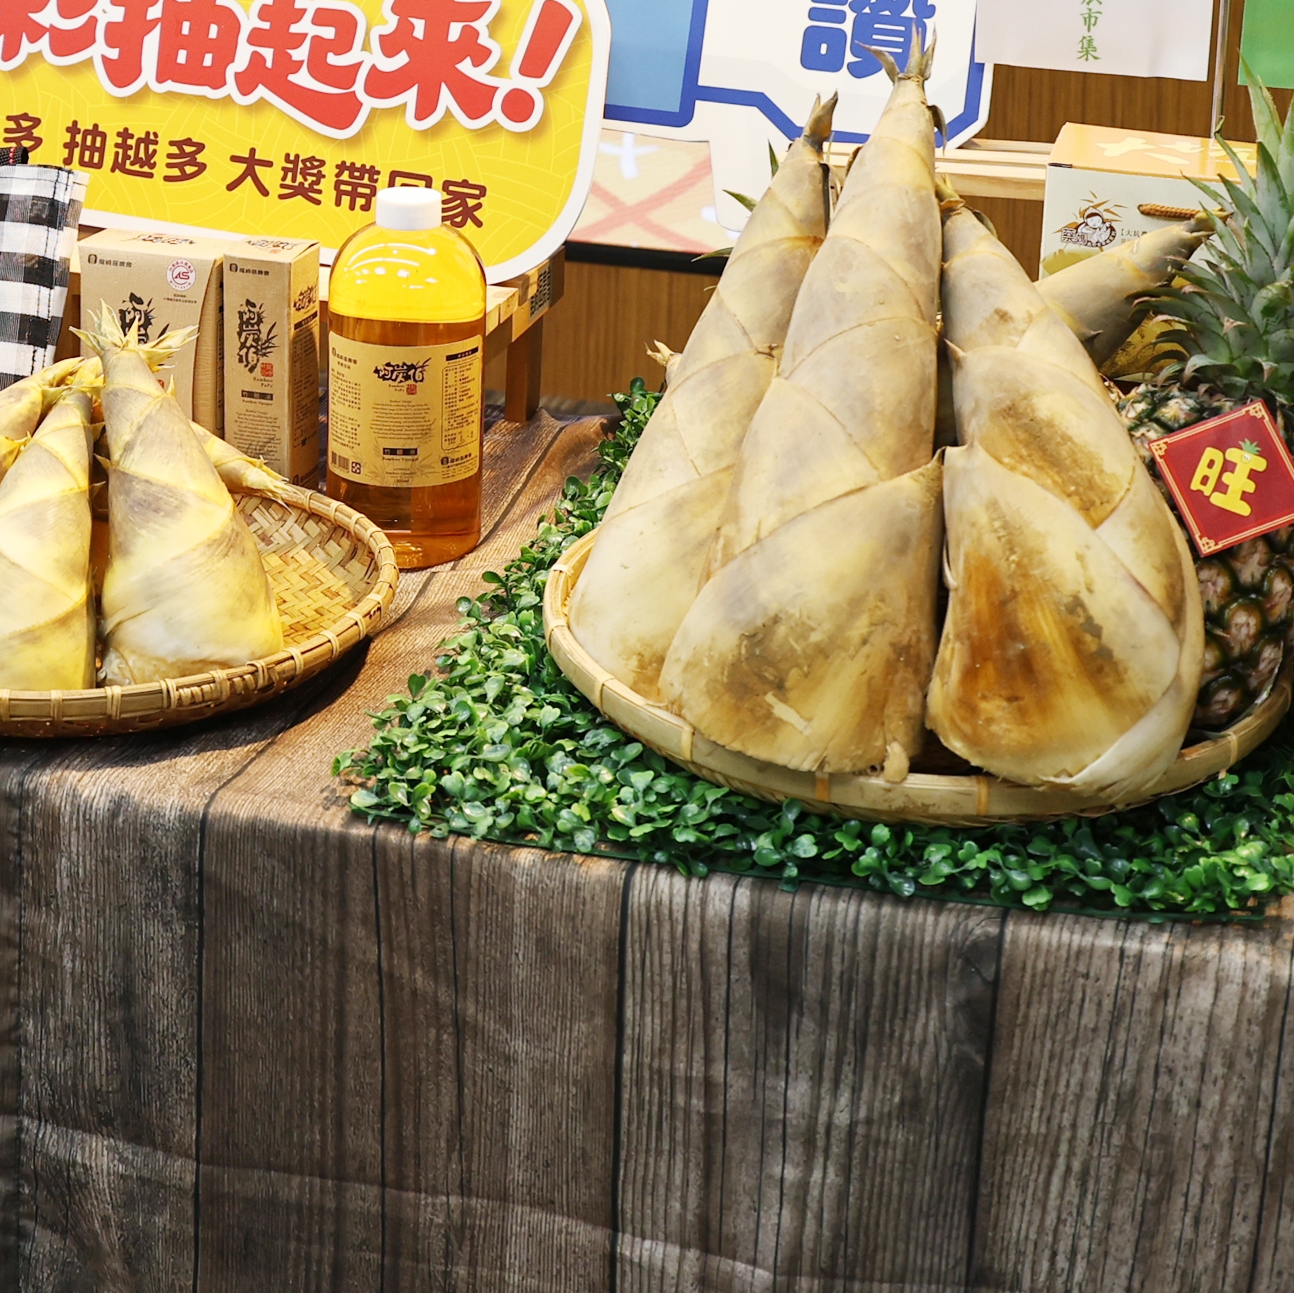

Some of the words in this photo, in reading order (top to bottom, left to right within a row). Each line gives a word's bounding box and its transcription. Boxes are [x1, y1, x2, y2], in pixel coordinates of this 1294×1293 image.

[62, 118, 208, 184] 抽越多
[1189, 445, 1268, 518] 旺
